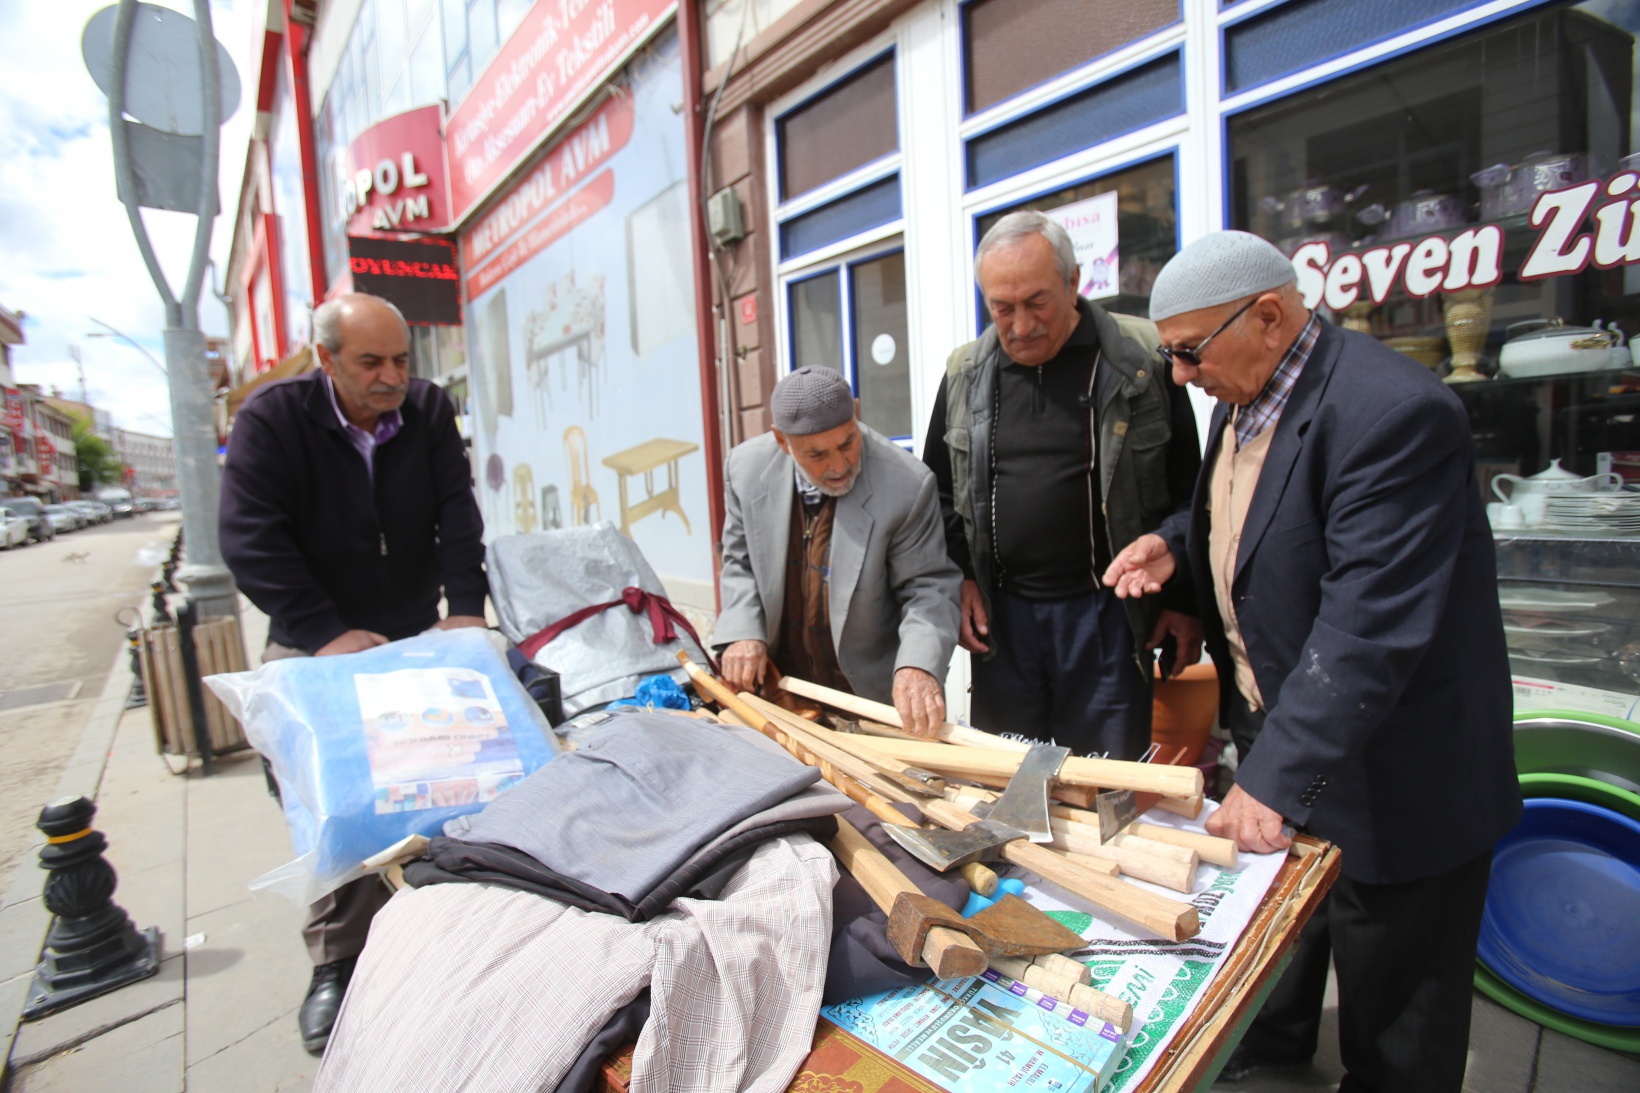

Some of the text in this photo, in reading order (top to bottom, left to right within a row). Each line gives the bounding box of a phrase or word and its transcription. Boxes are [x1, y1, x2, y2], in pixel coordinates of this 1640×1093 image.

[373, 194, 429, 229] AVM
[472, 165, 556, 259] METROPOL
[560, 113, 611, 186] AVM
[1290, 224, 1503, 311] Seven
[995, 1048, 1017, 1065] 41
